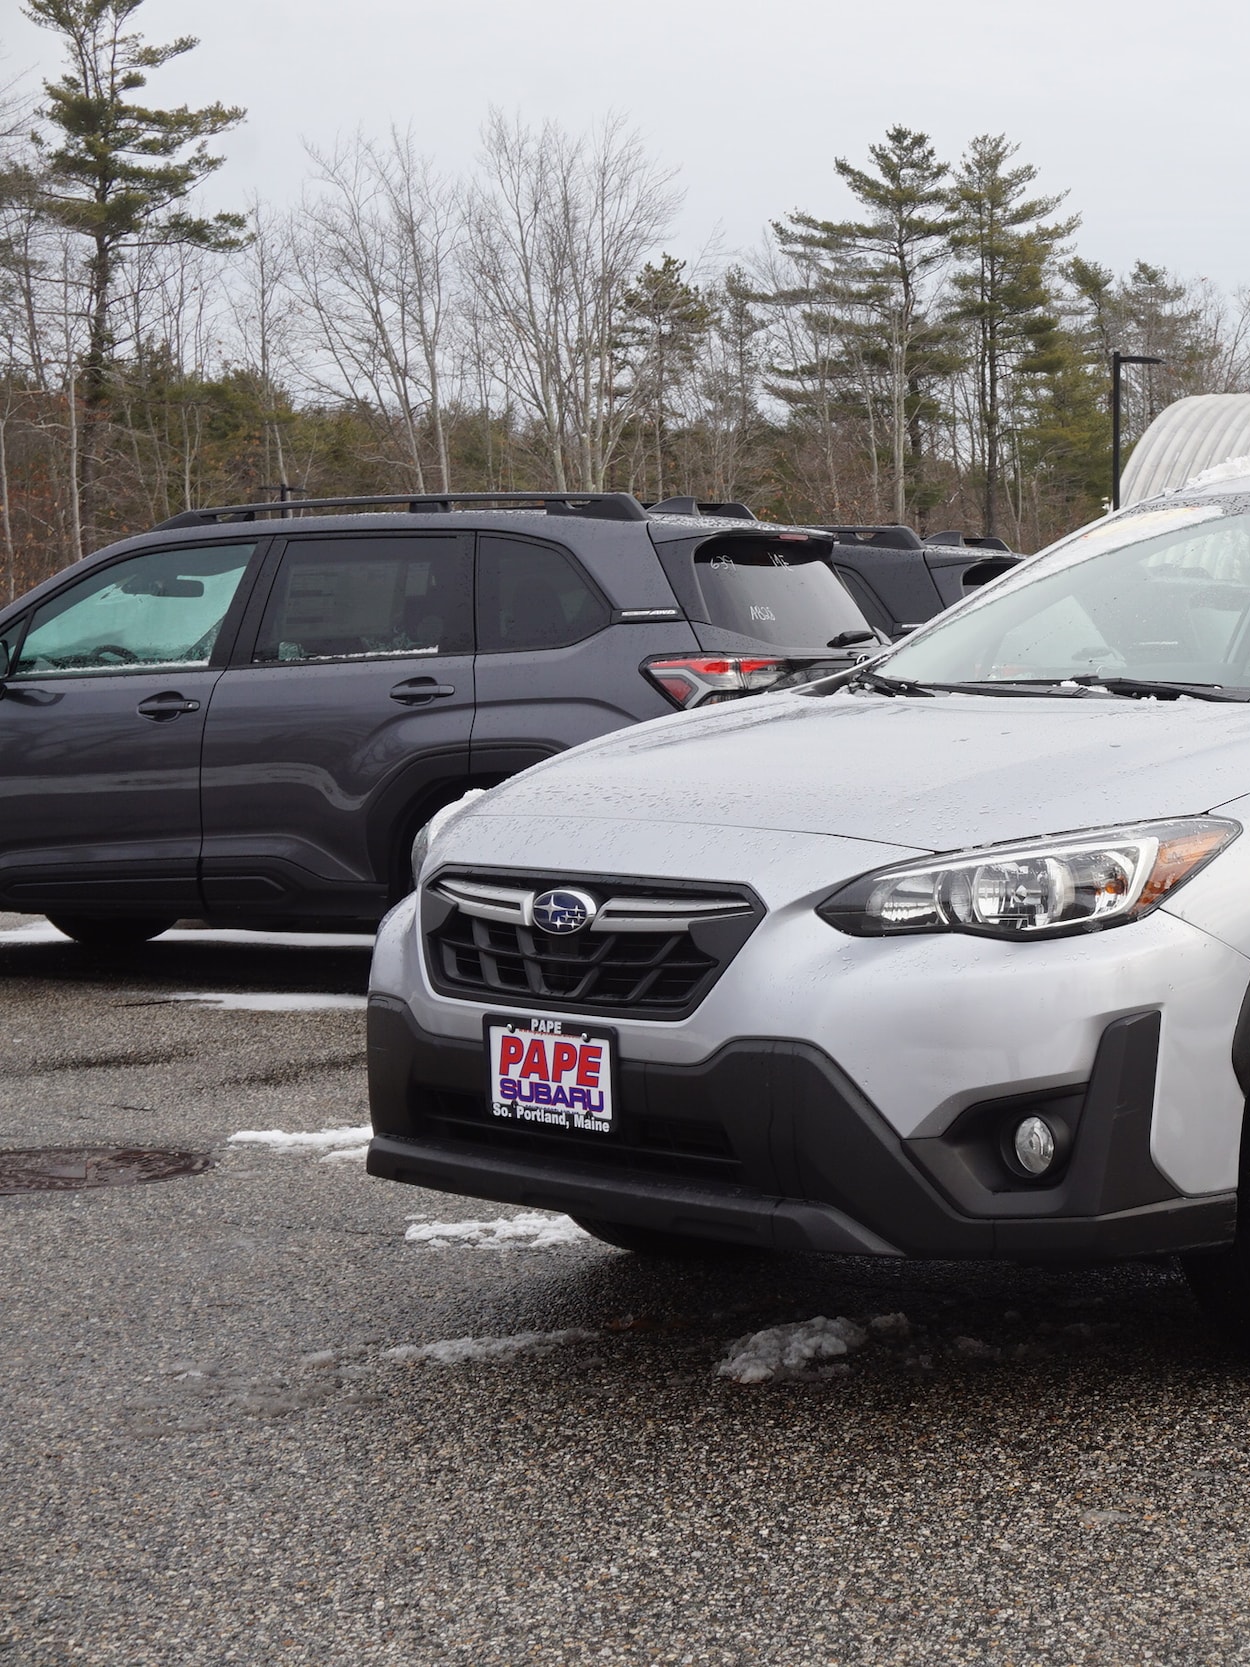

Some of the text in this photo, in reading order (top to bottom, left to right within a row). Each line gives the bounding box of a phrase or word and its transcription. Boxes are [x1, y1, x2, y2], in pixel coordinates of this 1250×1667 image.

[531, 1019, 562, 1034] PAPE
[499, 1035, 603, 1088] PAPE
[500, 1078, 604, 1113] SUBARU
[492, 1102, 513, 1118] So.
[517, 1105, 570, 1129] Portland,
[574, 1114, 610, 1132] Maine
